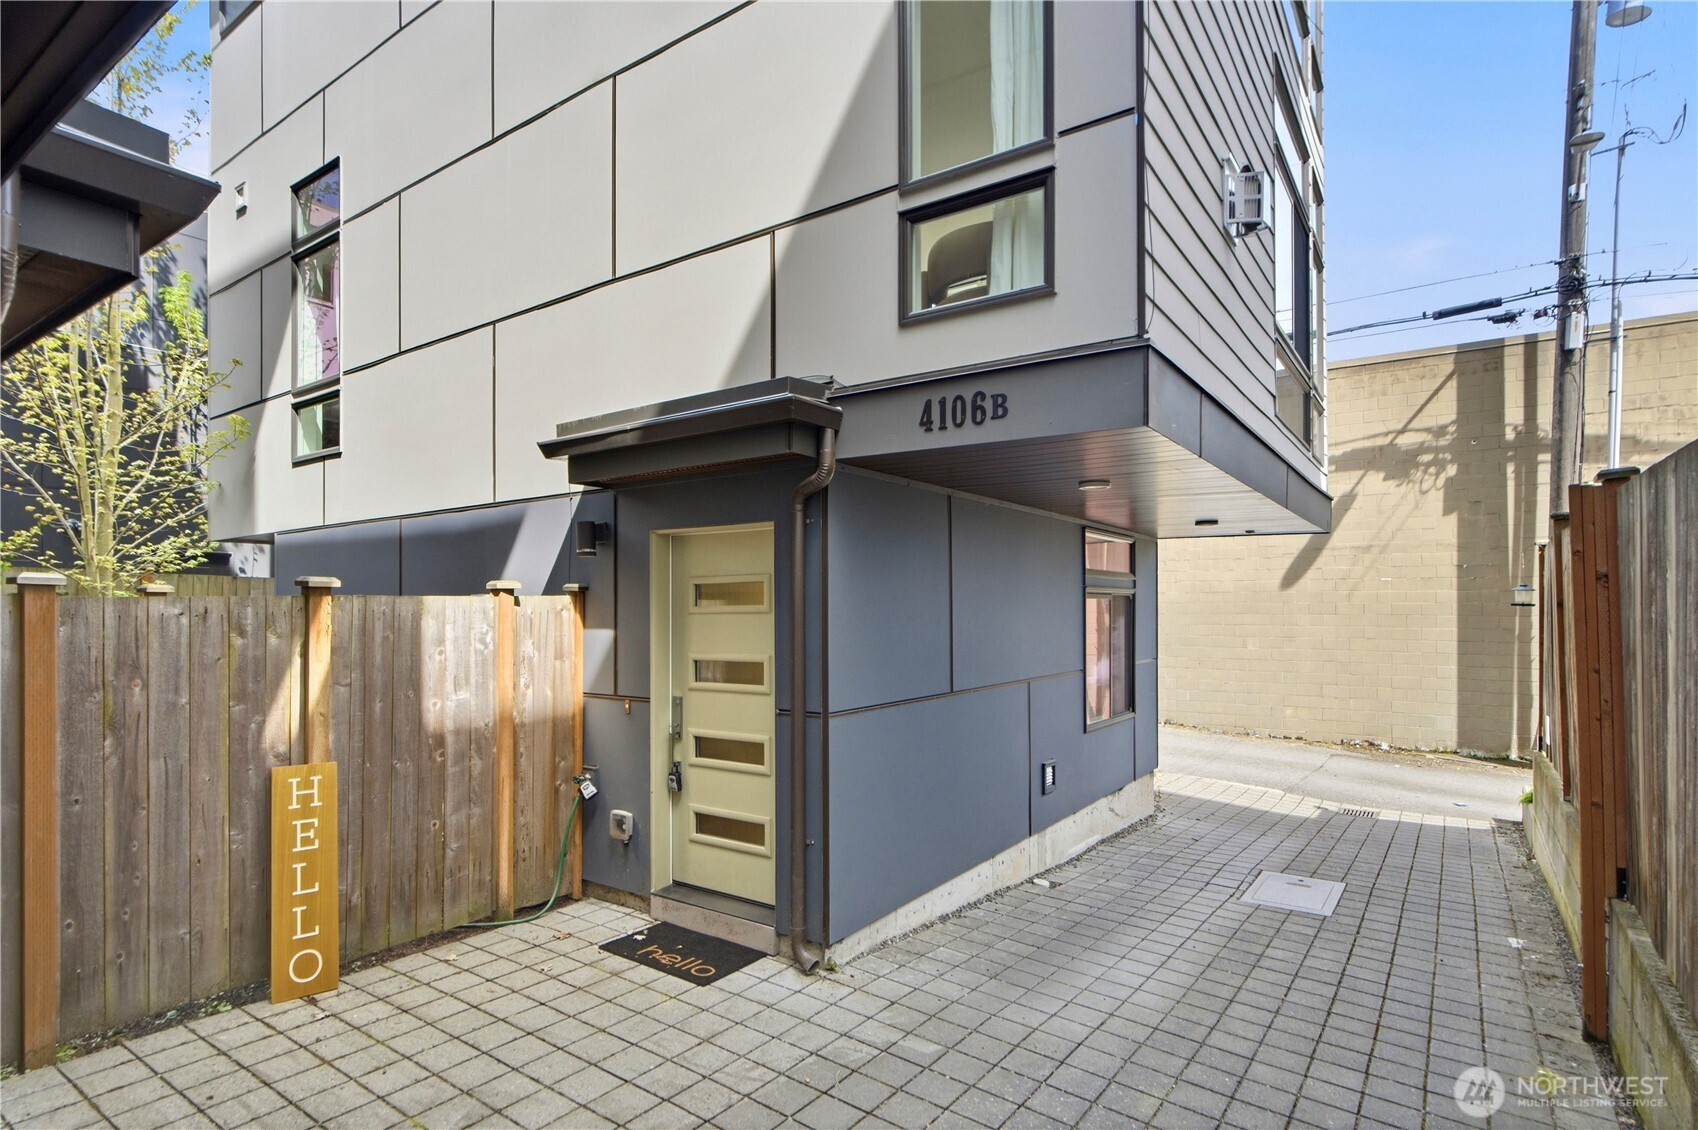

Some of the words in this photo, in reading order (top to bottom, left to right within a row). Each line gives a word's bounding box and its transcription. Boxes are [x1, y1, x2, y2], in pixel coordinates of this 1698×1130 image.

[919, 391, 1008, 432] 4106B
[288, 775, 323, 983] HELLO
[636, 944, 716, 977] hello
